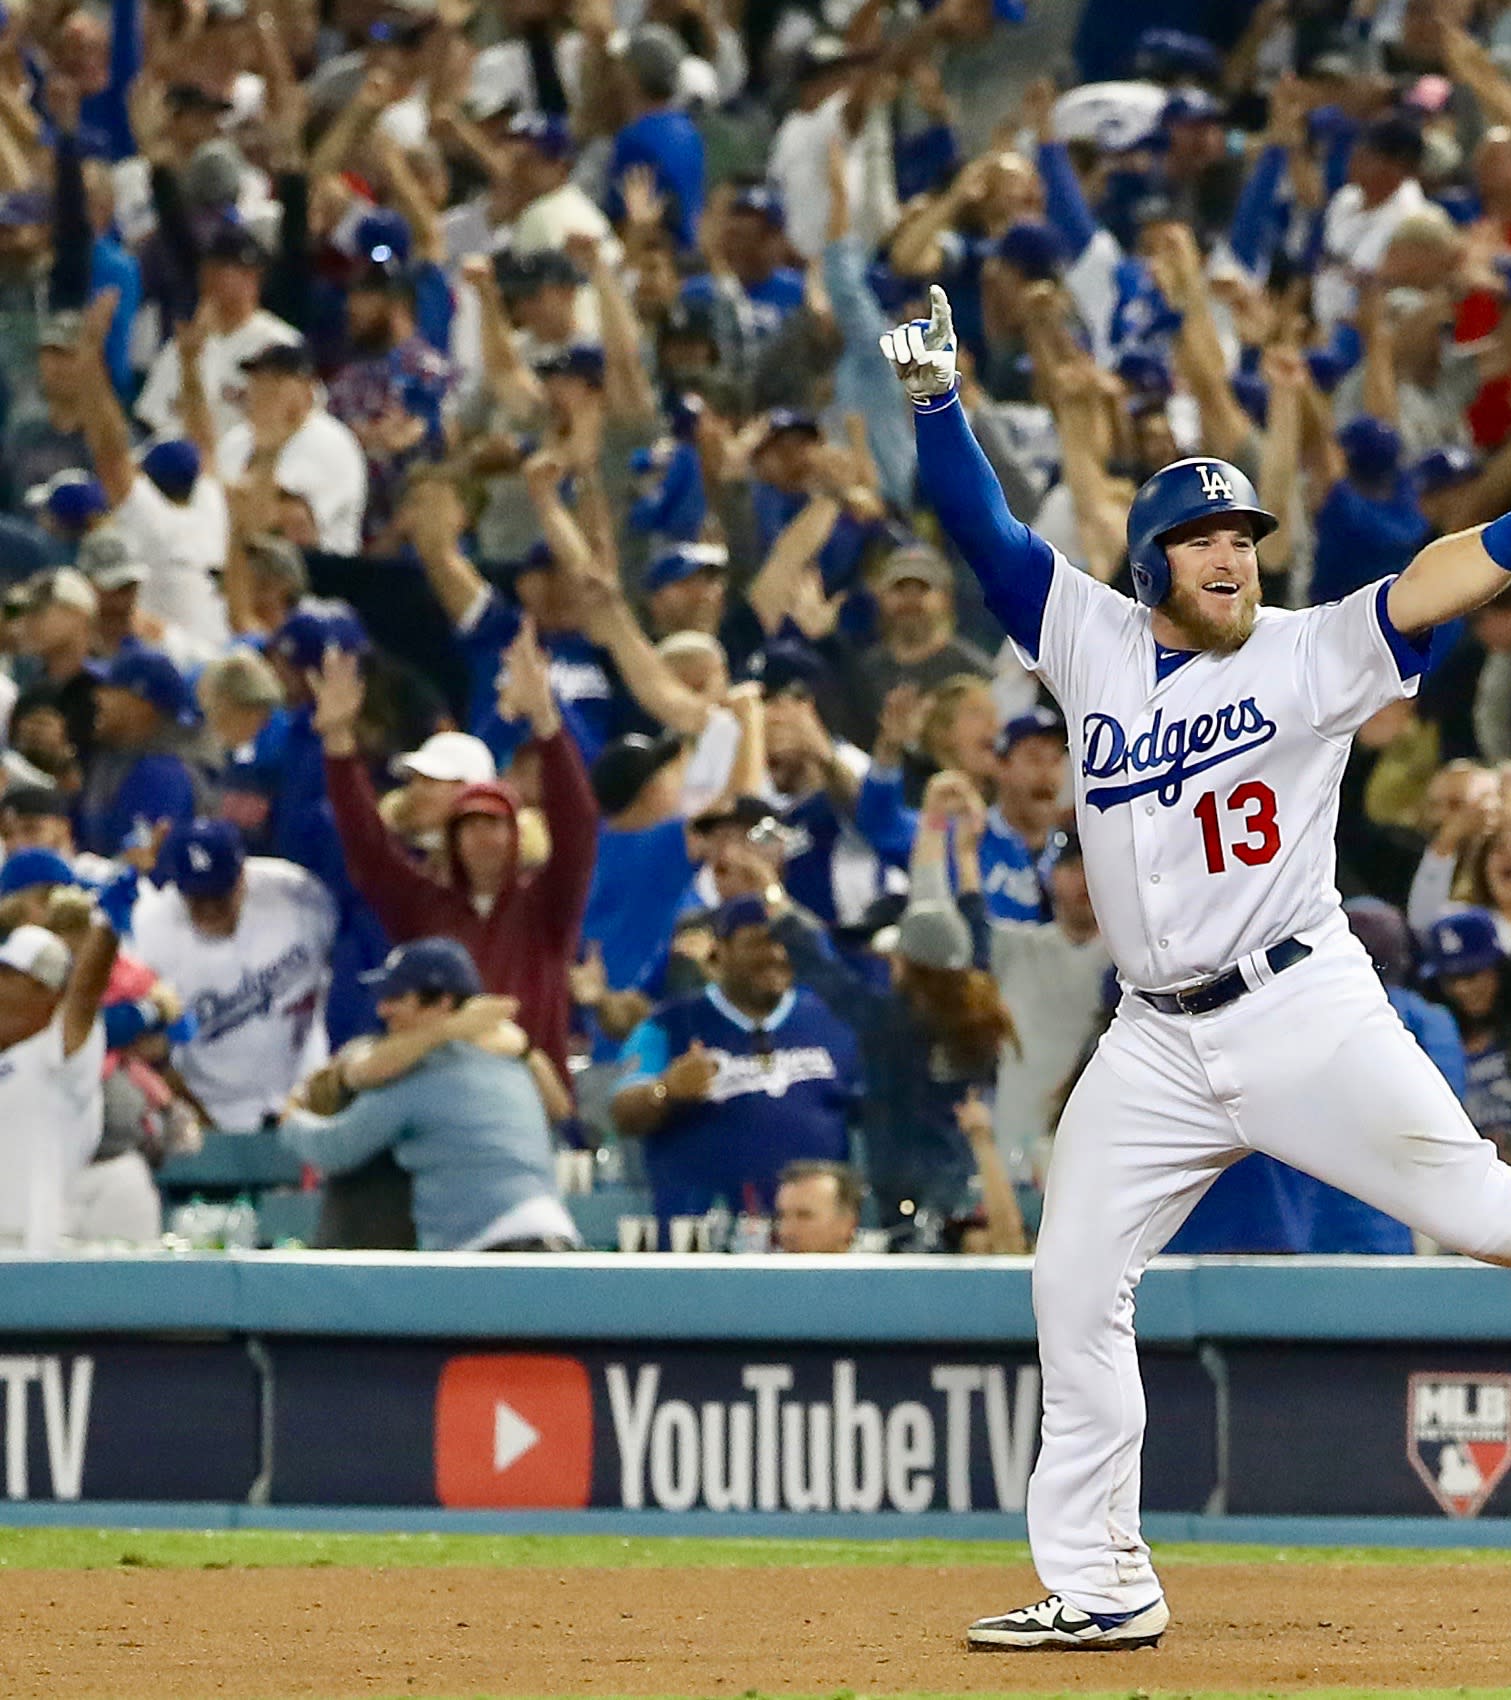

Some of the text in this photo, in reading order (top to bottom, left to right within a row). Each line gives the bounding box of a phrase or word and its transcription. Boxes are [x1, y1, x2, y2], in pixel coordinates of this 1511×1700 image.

[1196, 465, 1234, 500] LA
[1083, 697, 1277, 813] Ddgers
[1193, 781, 1281, 874] 13
[0, 1354, 95, 1500] TV
